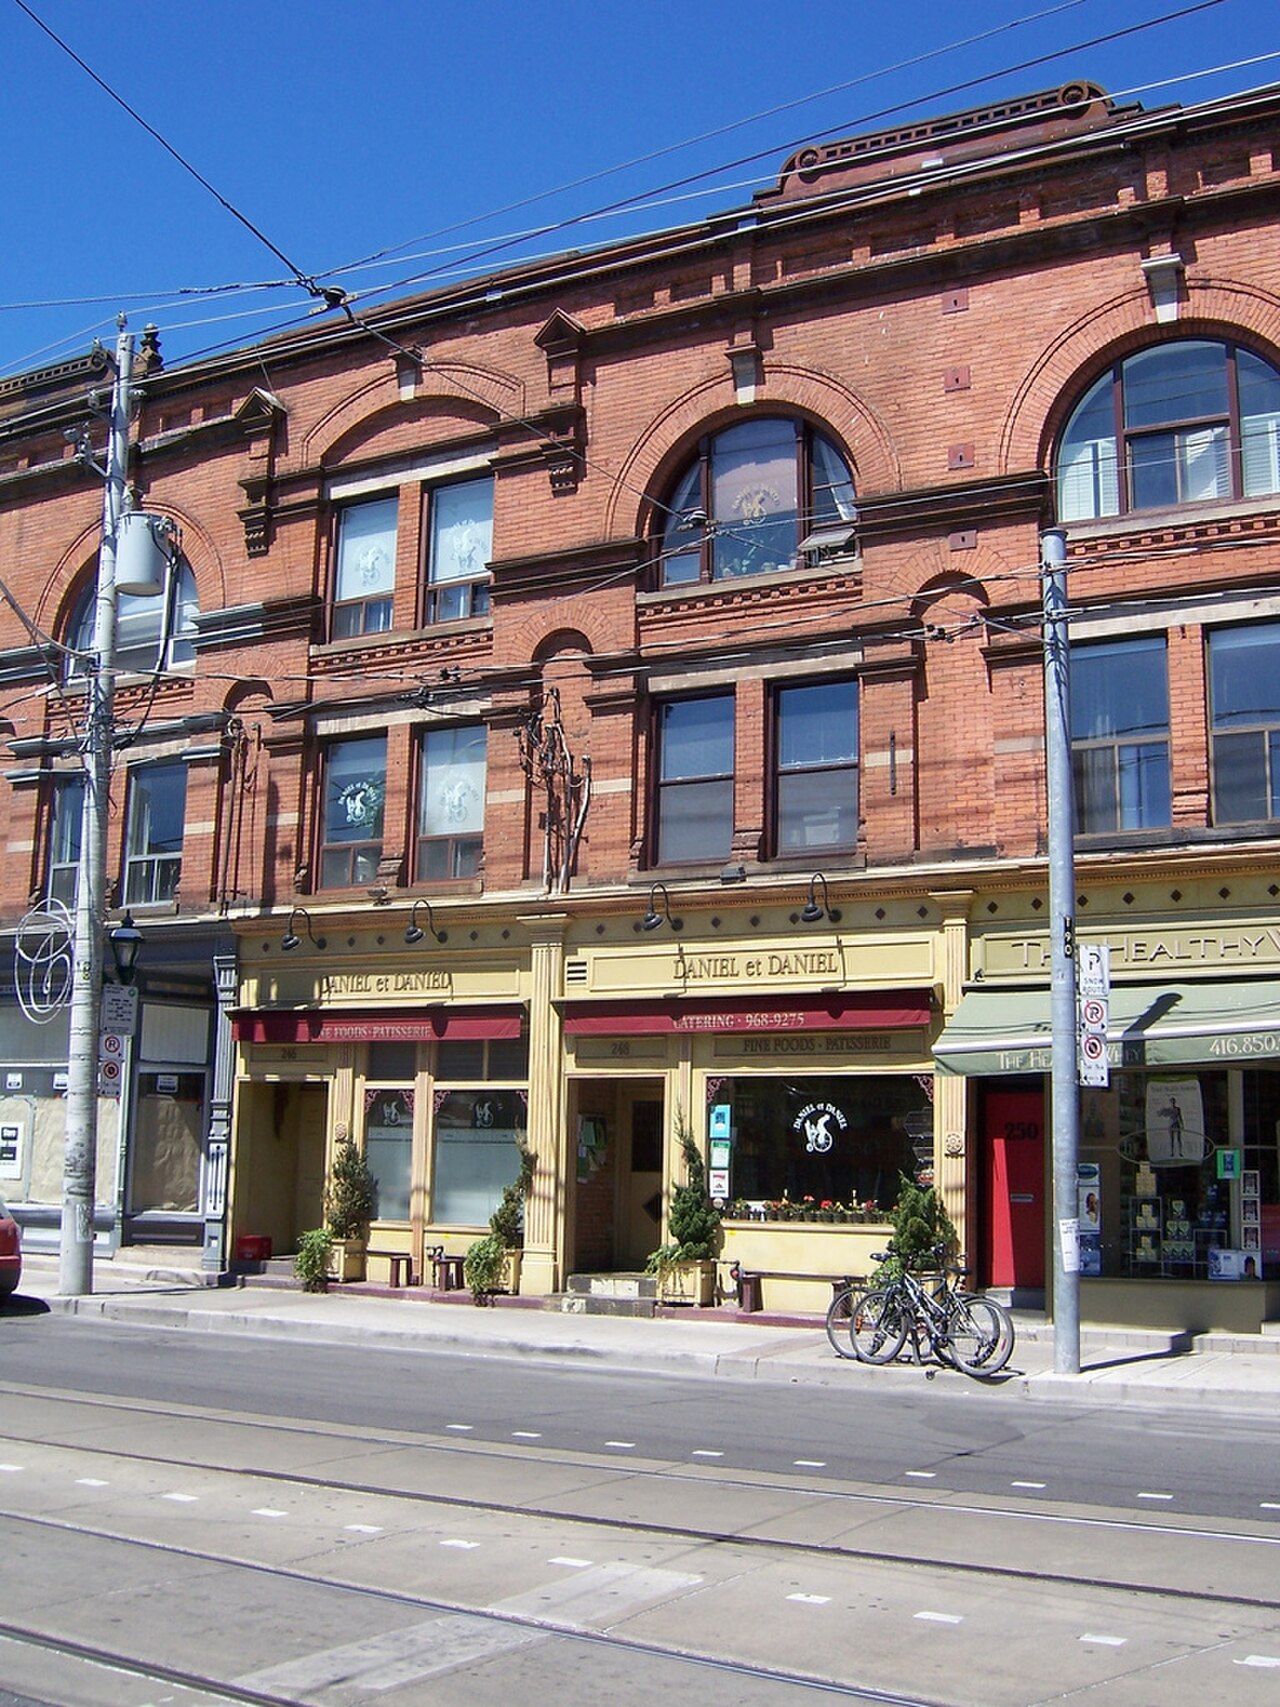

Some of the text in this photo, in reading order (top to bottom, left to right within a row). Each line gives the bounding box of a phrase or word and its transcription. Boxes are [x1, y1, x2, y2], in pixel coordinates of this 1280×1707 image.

[1103, 936, 1265, 963] HEALTHY
[673, 953, 838, 980] DANIEL et DANIEL
[321, 971, 448, 993] DANIEL et DANIEL
[745, 1012, 804, 1029] 968-9275
[335, 1027, 368, 1039] FOODS
[373, 1025, 432, 1039] PATISSERIE
[744, 1035, 892, 1052] FINE FOODS PATISSERIE
[1209, 1034, 1280, 1055] 416.850.
[1004, 1121, 1039, 1141] 250
